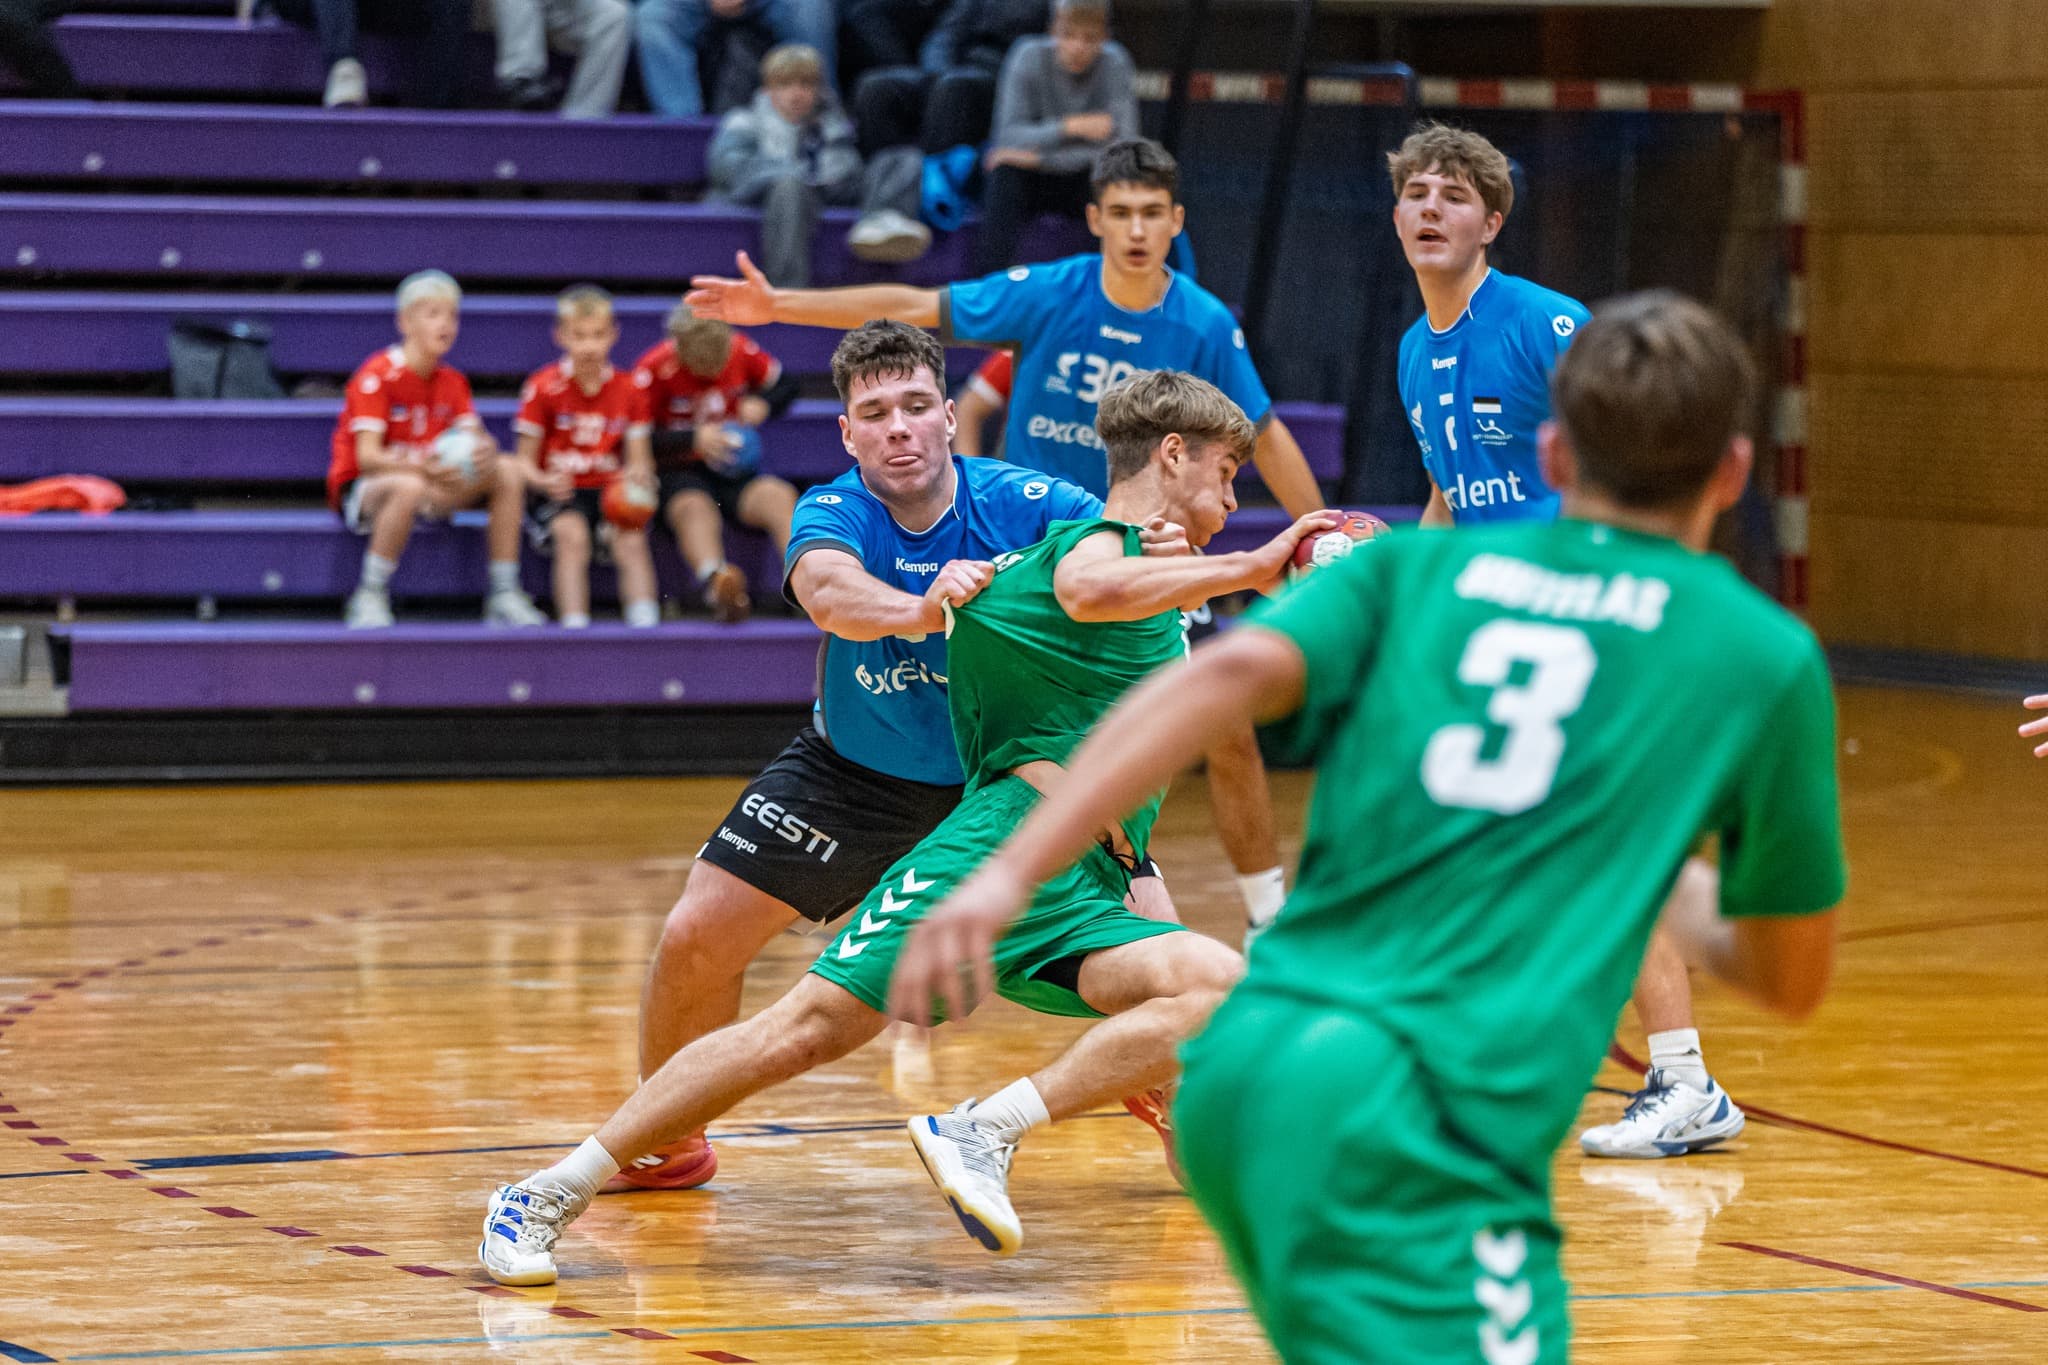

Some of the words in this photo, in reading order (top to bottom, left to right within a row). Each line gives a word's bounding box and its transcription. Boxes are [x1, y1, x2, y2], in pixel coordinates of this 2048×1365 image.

[895, 557, 938, 576] Kempa
[1419, 617, 1597, 814] 3
[718, 826, 758, 854] Kempa
[741, 793, 839, 863] EESTI
